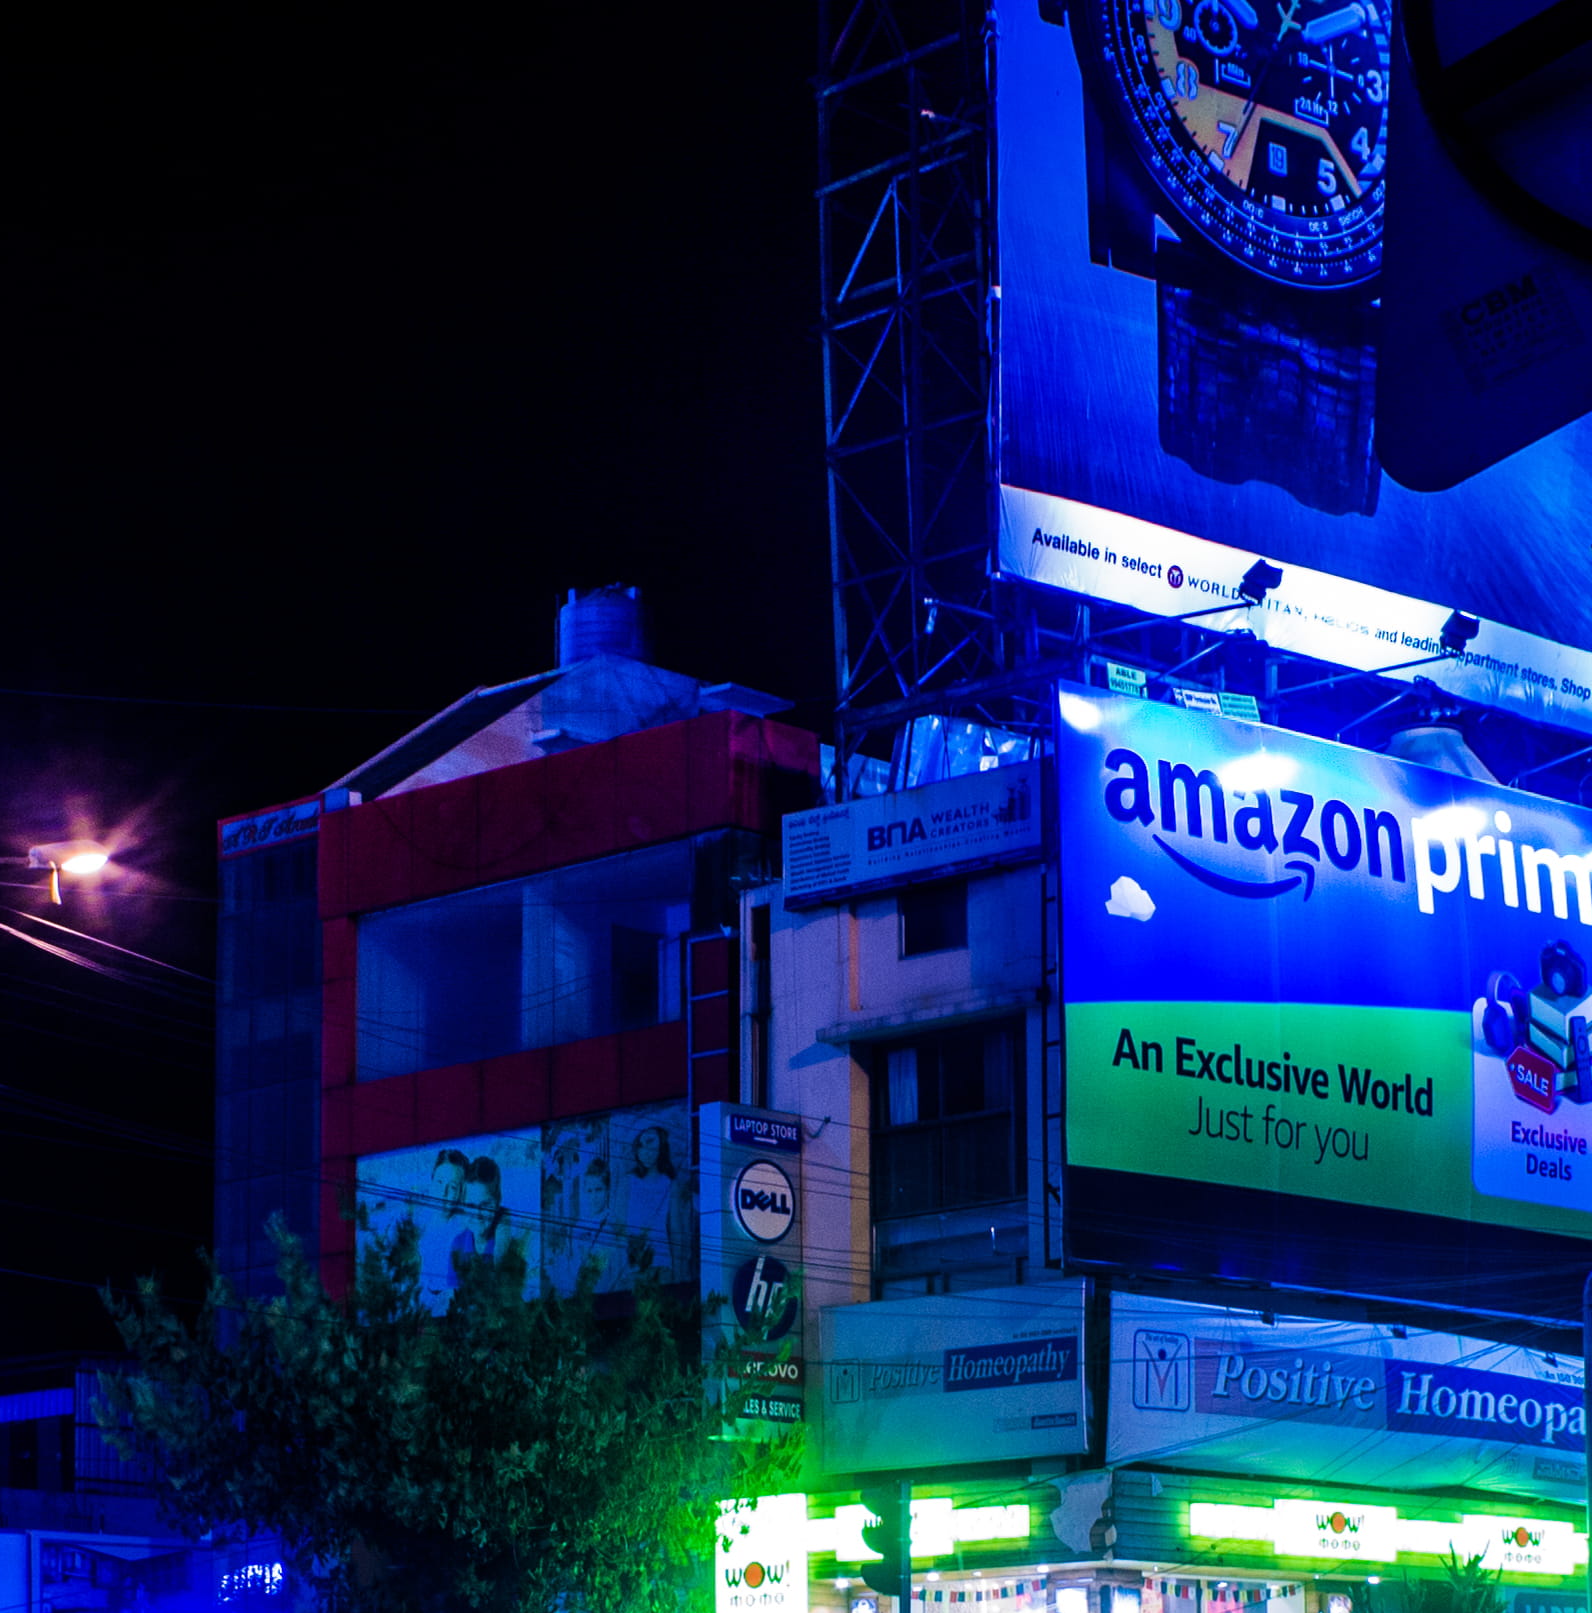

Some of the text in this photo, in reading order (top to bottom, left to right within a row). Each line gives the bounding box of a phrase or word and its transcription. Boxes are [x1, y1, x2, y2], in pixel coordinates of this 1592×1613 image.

[1366, 69, 1383, 103] 3
[1217, 121, 1237, 159] 7
[1350, 126, 1371, 161] 4
[1317, 157, 1337, 195] 5
[1032, 528, 1100, 560] Available
[1104, 547, 1117, 565] in
[1121, 555, 1163, 579] select
[1521, 667, 1558, 692] stores.
[1560, 677, 1591, 701] Shop
[930, 802, 990, 824] WEALTH
[1104, 748, 1406, 883] amazon
[1112, 1028, 1434, 1116] An Exclusive World
[1516, 1065, 1550, 1095] SALE
[733, 1116, 798, 1141] LAPTOP STORE
[1190, 1096, 1369, 1165] Just for you
[1511, 1120, 1588, 1155] Exclusive
[1525, 1156, 1573, 1183] Deals
[741, 1188, 791, 1216] DELL
[868, 1362, 939, 1393] Positive
[948, 1344, 1070, 1384] Homeopathy
[1214, 1351, 1376, 1412] Positive
[770, 1401, 801, 1418] SERVICE
